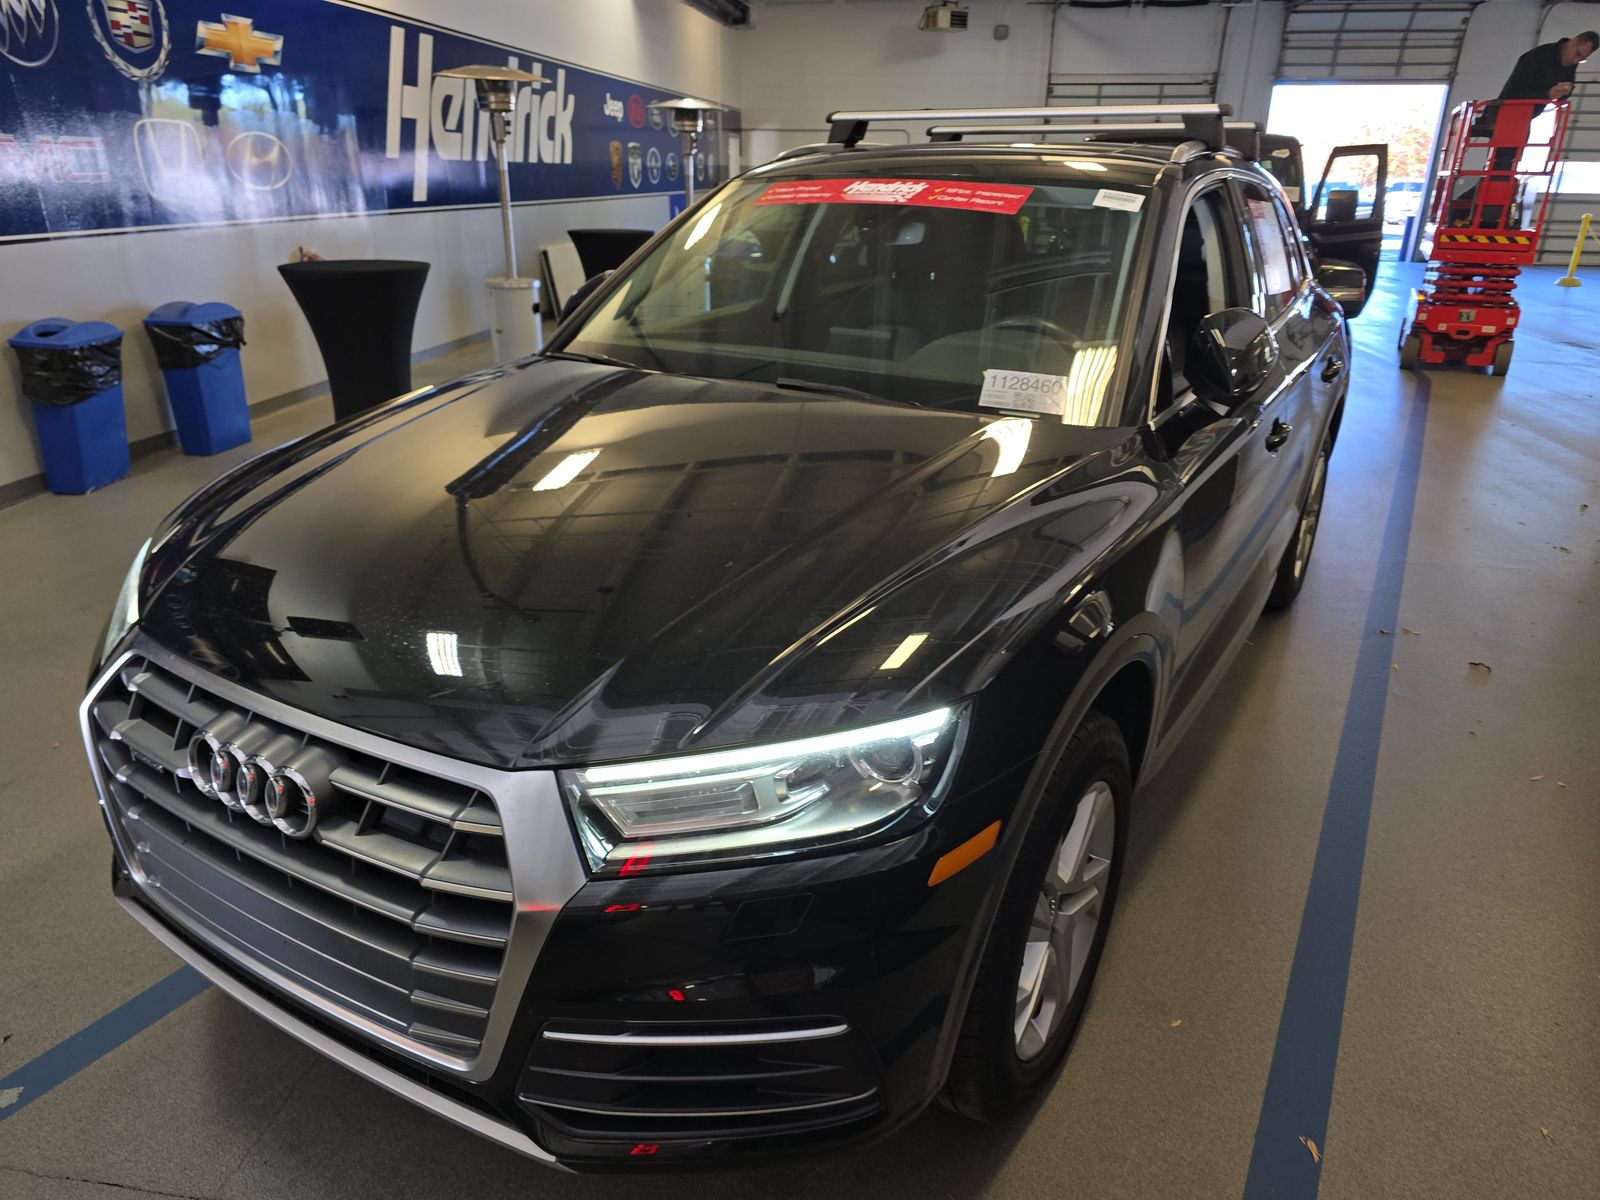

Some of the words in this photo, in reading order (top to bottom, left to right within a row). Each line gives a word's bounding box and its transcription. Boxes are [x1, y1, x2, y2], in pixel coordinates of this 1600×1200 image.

[602, 92, 625, 122] Jeep
[0, 134, 110, 184] MC
[990, 374, 1063, 395] 1128460
